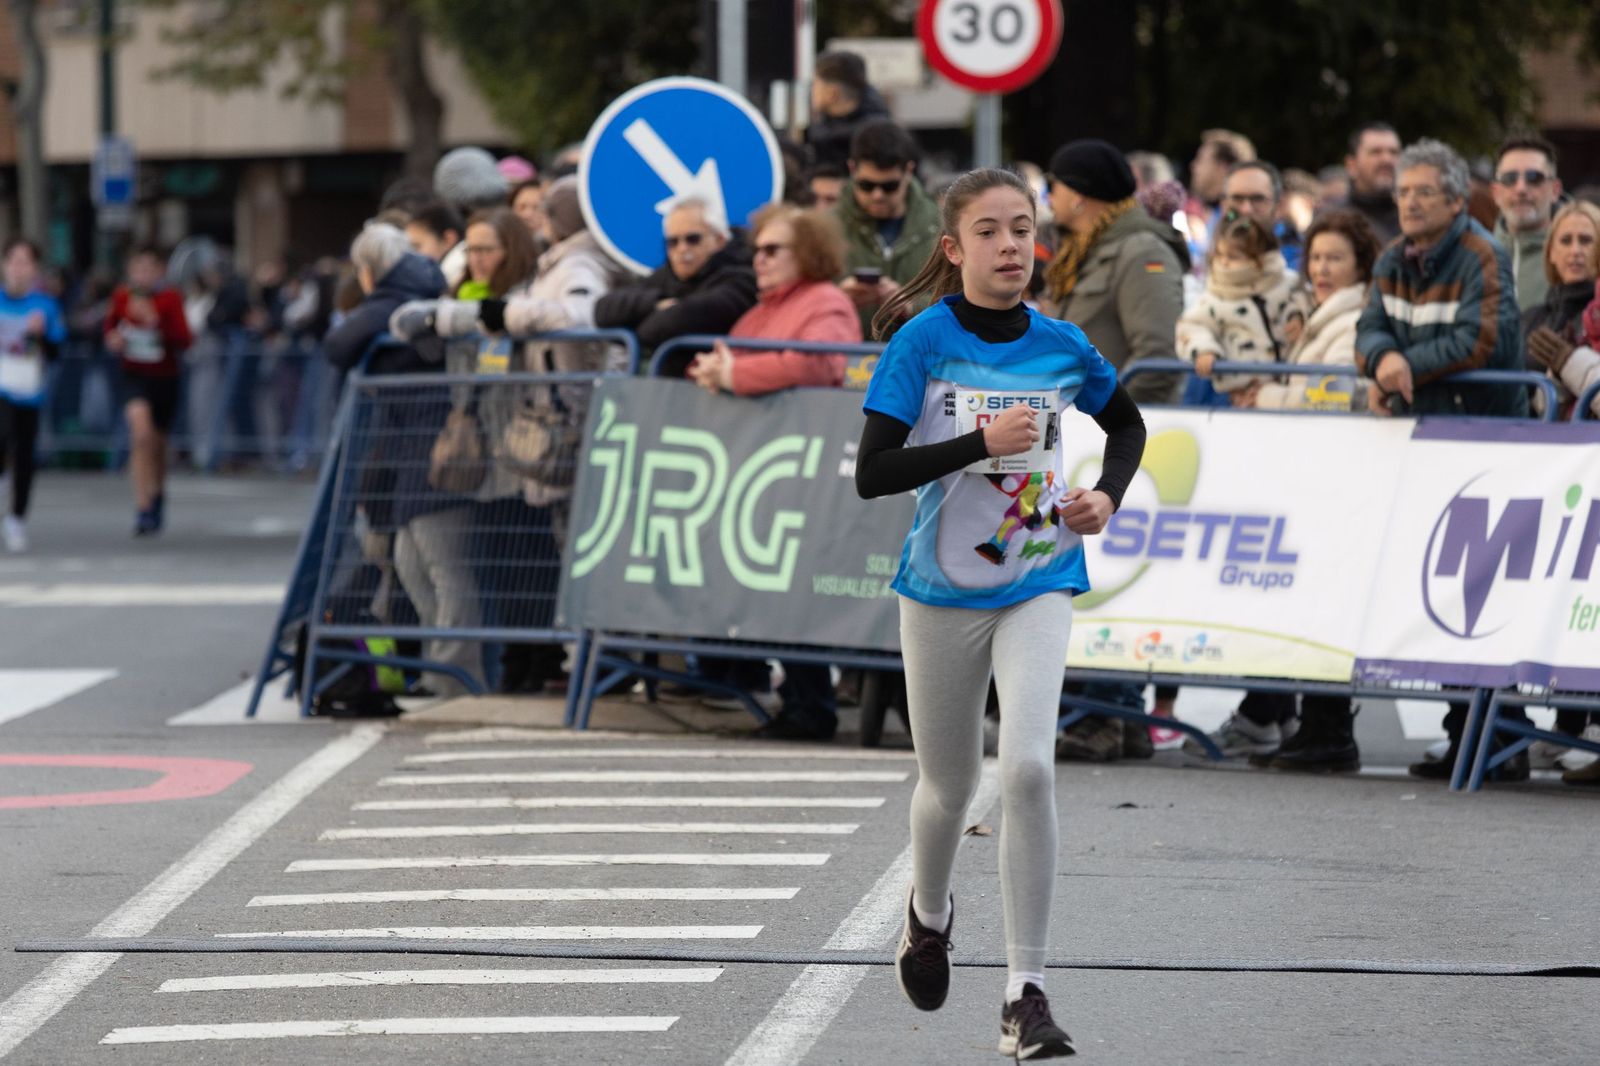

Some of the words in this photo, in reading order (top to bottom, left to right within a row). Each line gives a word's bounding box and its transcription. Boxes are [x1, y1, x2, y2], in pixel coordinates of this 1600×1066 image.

[951, 2, 1023, 44] 30
[987, 396, 1051, 409] SETEL
[571, 397, 824, 592] JRG
[1102, 509, 1299, 565] SETEL
[1219, 564, 1295, 591] Grupo
